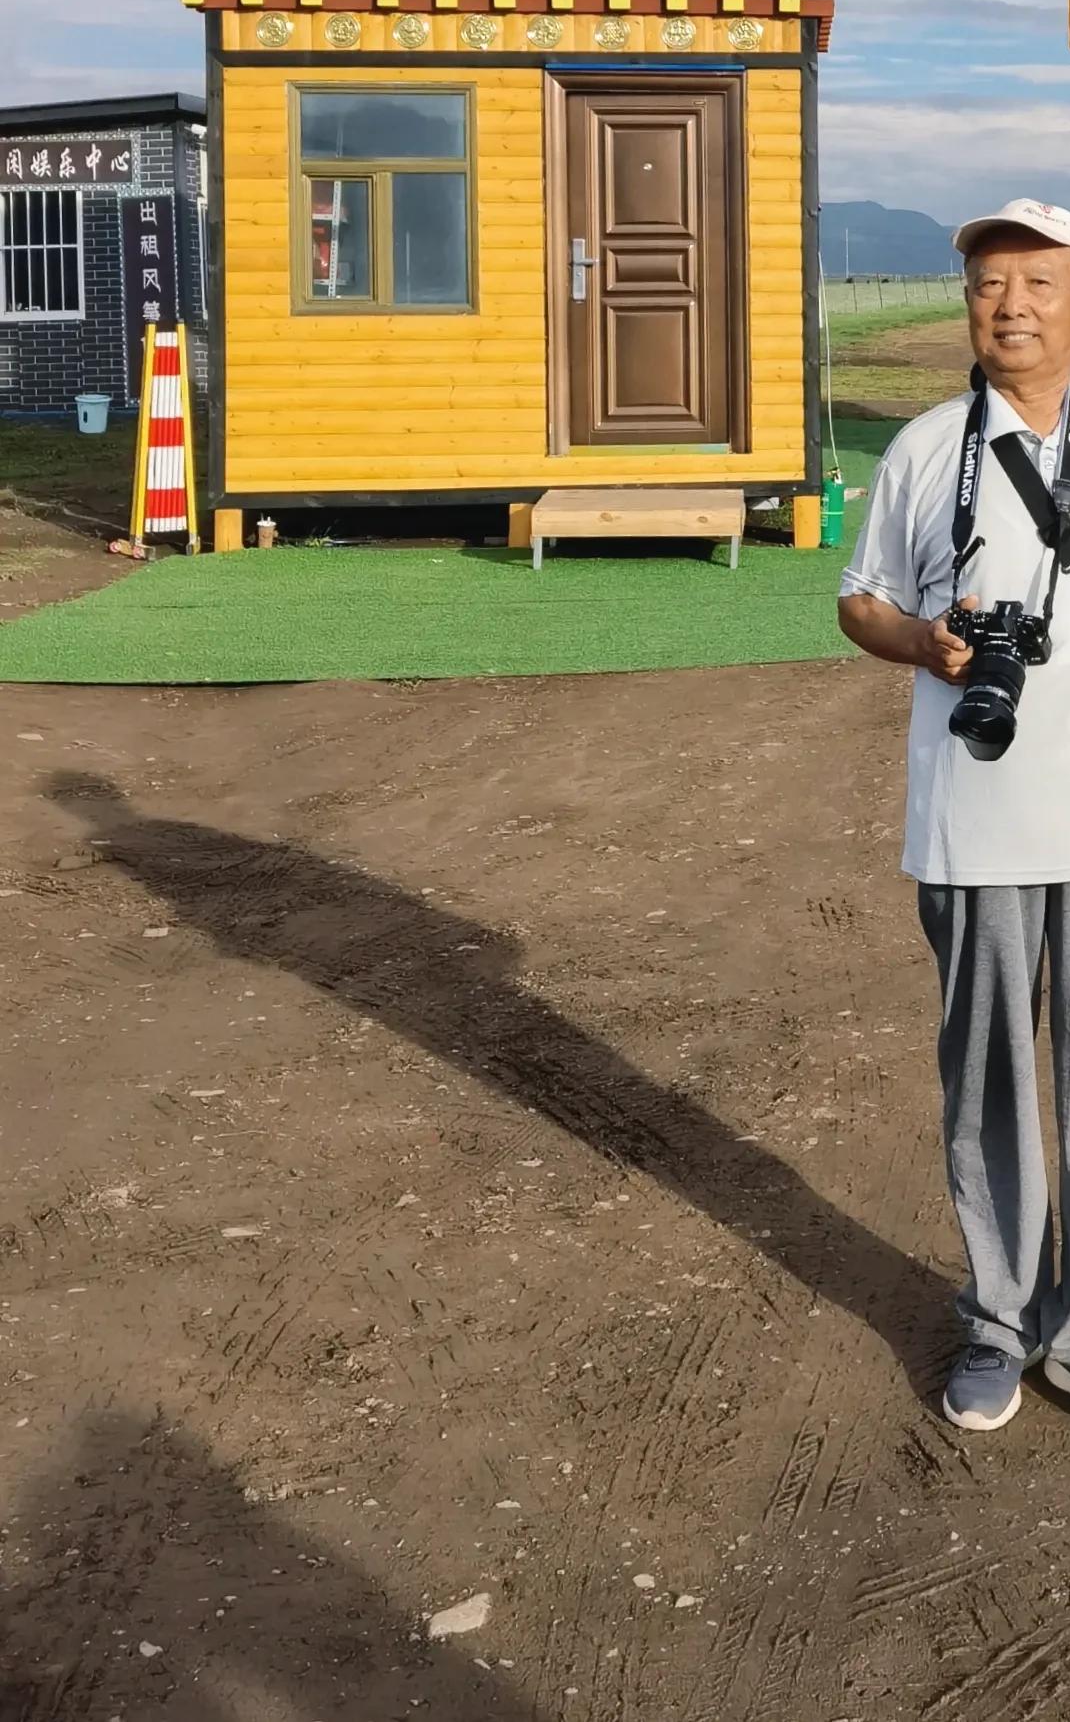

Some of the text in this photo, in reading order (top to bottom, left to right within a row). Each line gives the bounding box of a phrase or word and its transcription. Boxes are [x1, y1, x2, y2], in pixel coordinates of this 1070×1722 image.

[5, 143, 131, 181] 闲娱乐中心
[139, 200, 162, 352] 出租风筝
[960, 431, 979, 507] OLYMPUS
